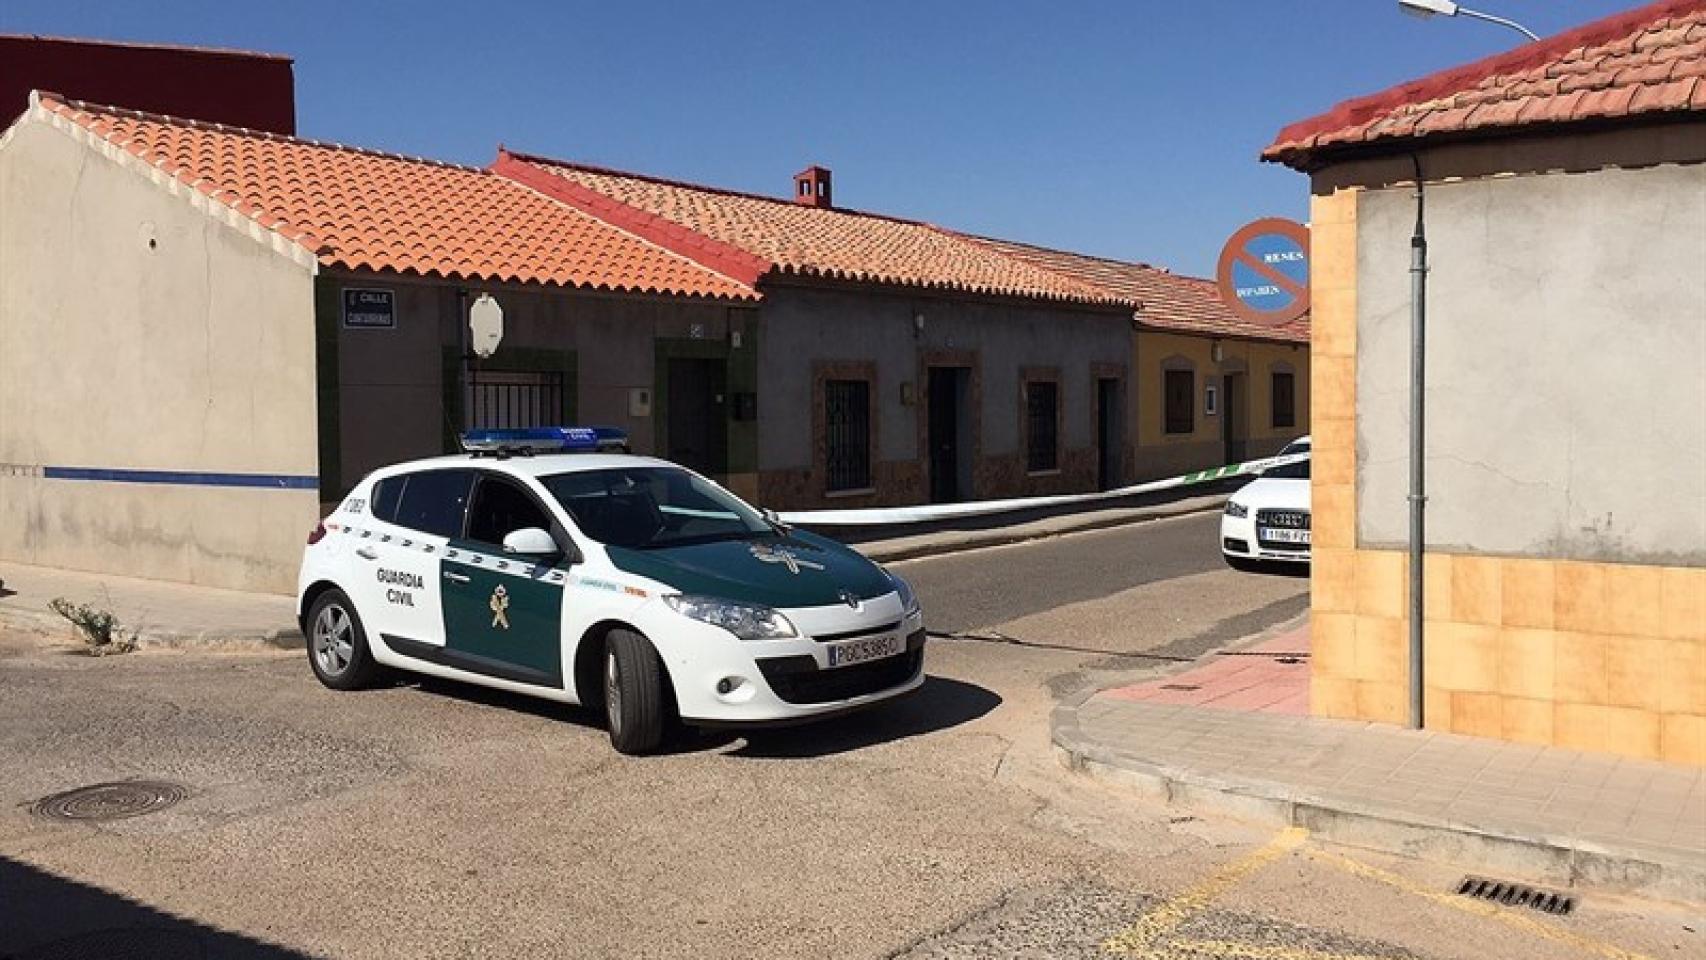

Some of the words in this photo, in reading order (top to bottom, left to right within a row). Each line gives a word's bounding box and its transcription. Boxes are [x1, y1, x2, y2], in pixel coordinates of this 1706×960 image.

[359, 292, 389, 304] CALLE
[376, 567, 425, 590] GUARDIA
[387, 588, 415, 607] CIVIL
